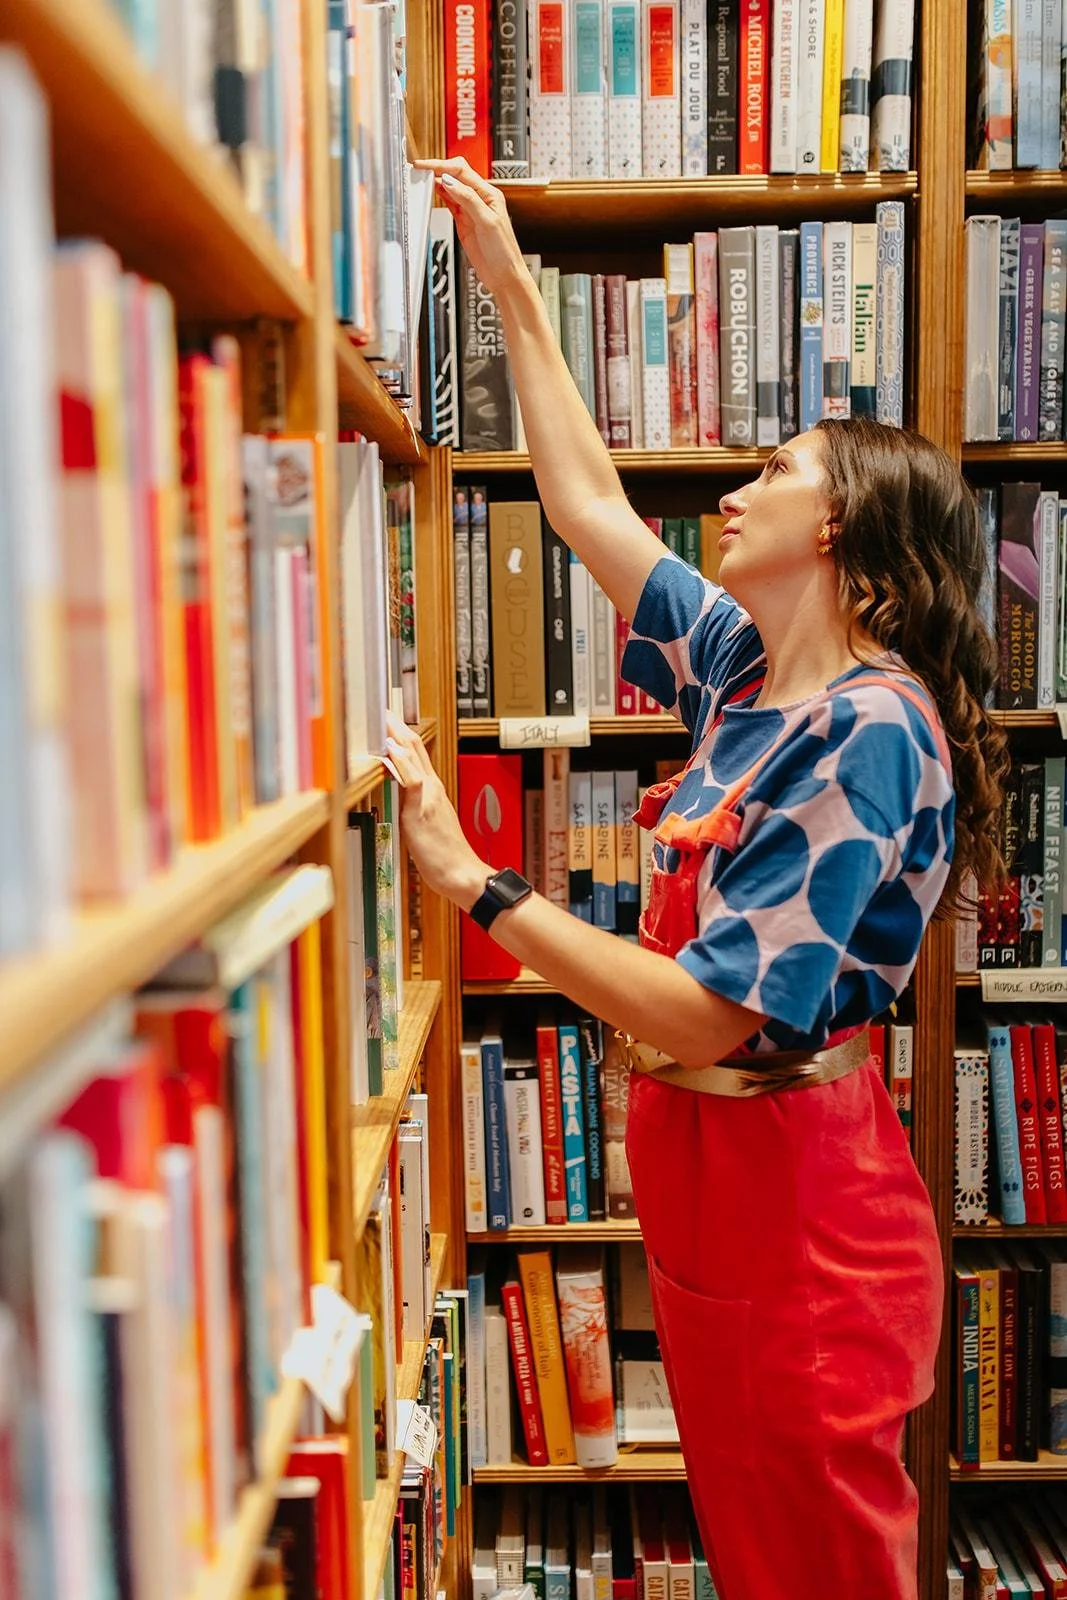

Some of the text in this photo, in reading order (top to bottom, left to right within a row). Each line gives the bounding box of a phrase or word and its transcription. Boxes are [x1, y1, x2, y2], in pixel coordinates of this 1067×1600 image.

[716, 6, 730, 61] Regional
[747, 15, 762, 80] MICHEL
[780, 10, 793, 98] PARIS KITCHEN
[807, 19, 817, 59] SHORE
[456, 5, 475, 140] COOKING SCHOOL
[689, 22, 700, 122] PLAT DU JOUR
[717, 65, 730, 97] Food
[747, 83, 762, 131] ROUX
[762, 237, 771, 251] AS
[762, 252, 772, 279] THE
[806, 235, 817, 294] PROVENCE
[999, 230, 1019, 296] MAZI
[762, 280, 773, 331] ROMANS
[831, 241, 846, 325] RICK STEIN'S
[886, 272, 897, 295] Naples
[887, 297, 896, 314] and
[1025, 268, 1035, 309] GREEK
[467, 268, 477, 357] GASTRONOMIQUE
[477, 281, 496, 357] OCUSE
[730, 267, 748, 395] ROBUCHON
[855, 284, 874, 353] Italian
[887, 315, 896, 326] the
[1046, 248, 1062, 409] SEA SALT AND HONEY
[1023, 312, 1034, 387] VEGETARIAN
[829, 357, 848, 414] FCE
[455, 533, 469, 560] Rick
[473, 533, 486, 560] Rick
[688, 527, 696, 550] Anna
[1044, 543, 1055, 584] Blossom
[456, 564, 470, 605] Stein's
[474, 564, 488, 605] Stein's
[1043, 595, 1053, 626] Honey
[1010, 603, 1022, 692] MOROCCO
[1022, 611, 1035, 690] The FOOD of
[520, 725, 559, 744] ITALY
[574, 803, 585, 861] SARDINE
[598, 802, 609, 860] SARDINE
[622, 800, 633, 859] SARDINE
[1046, 786, 1061, 828] NEW
[549, 831, 567, 906] EATAL
[1046, 836, 1060, 893] FEAST
[899, 1038, 907, 1073] GINO'S
[543, 1058, 556, 1138] PERFECT PASTA
[560, 1035, 582, 1136] PASTA
[605, 1069, 618, 1108] ITALY
[467, 1096, 475, 1142] ENCYCLOPEDIA
[588, 1098, 599, 1129] HOME
[969, 1100, 980, 1168] MIDDLE EASTERN
[994, 1058, 1018, 1177] SAFFRON TALES
[519, 1135, 532, 1155] VINO
[589, 1131, 600, 1179] COOKING
[1022, 1117, 1040, 1190] RIPE FIGS
[1045, 1116, 1062, 1190] RIPE FIGS
[492, 1179, 502, 1193] Italy
[508, 1296, 518, 1320] MAKING
[527, 1271, 551, 1381] Gastronomy of Italy
[543, 1303, 555, 1322] Del
[1004, 1289, 1013, 1380] EAT SHARE LOVE
[511, 1321, 527, 1354] ARTISAN
[546, 1325, 558, 1360] Conte
[963, 1325, 979, 1373] INDIA
[518, 1356, 532, 1380] PIZZA
[982, 1326, 996, 1412] KHAZANA
[967, 1383, 975, 1444] MEERA SODHA
